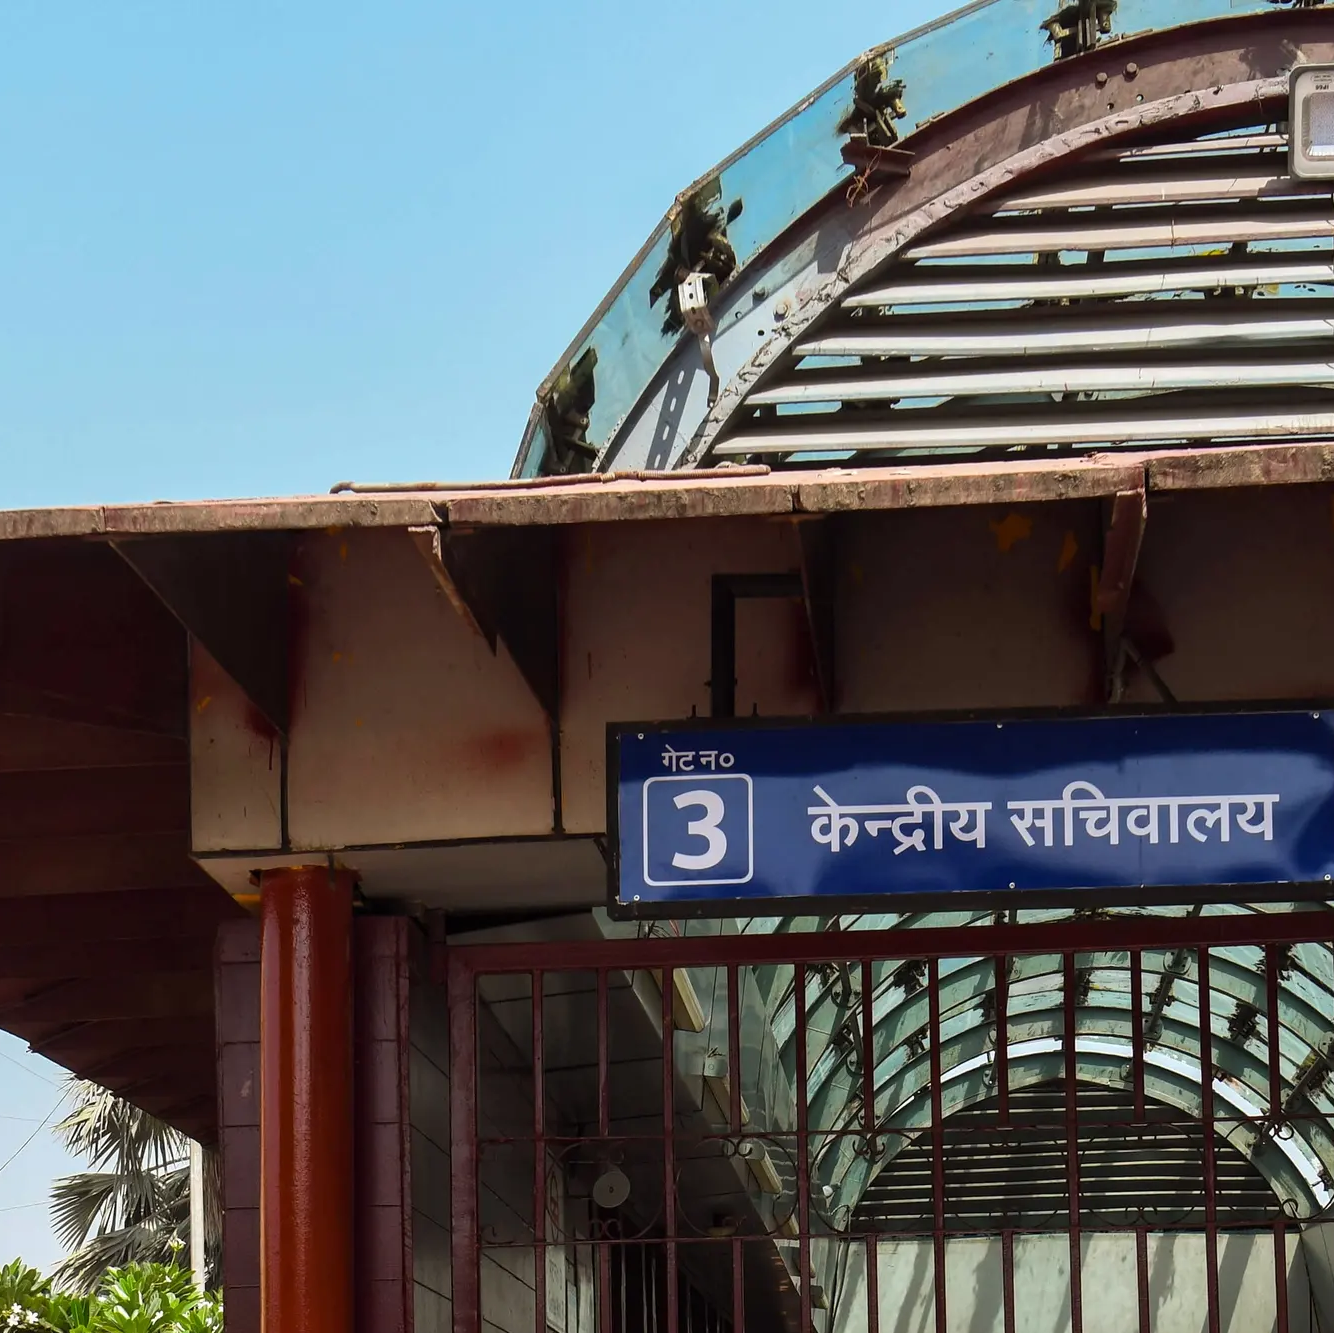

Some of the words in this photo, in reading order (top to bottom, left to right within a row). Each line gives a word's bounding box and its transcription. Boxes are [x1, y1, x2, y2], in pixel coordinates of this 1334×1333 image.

[662, 744, 696, 772] गेट
[671, 789, 728, 870] 3
[807, 785, 993, 855] केन्द्रीय
[1007, 780, 1281, 848] सचिवालय
